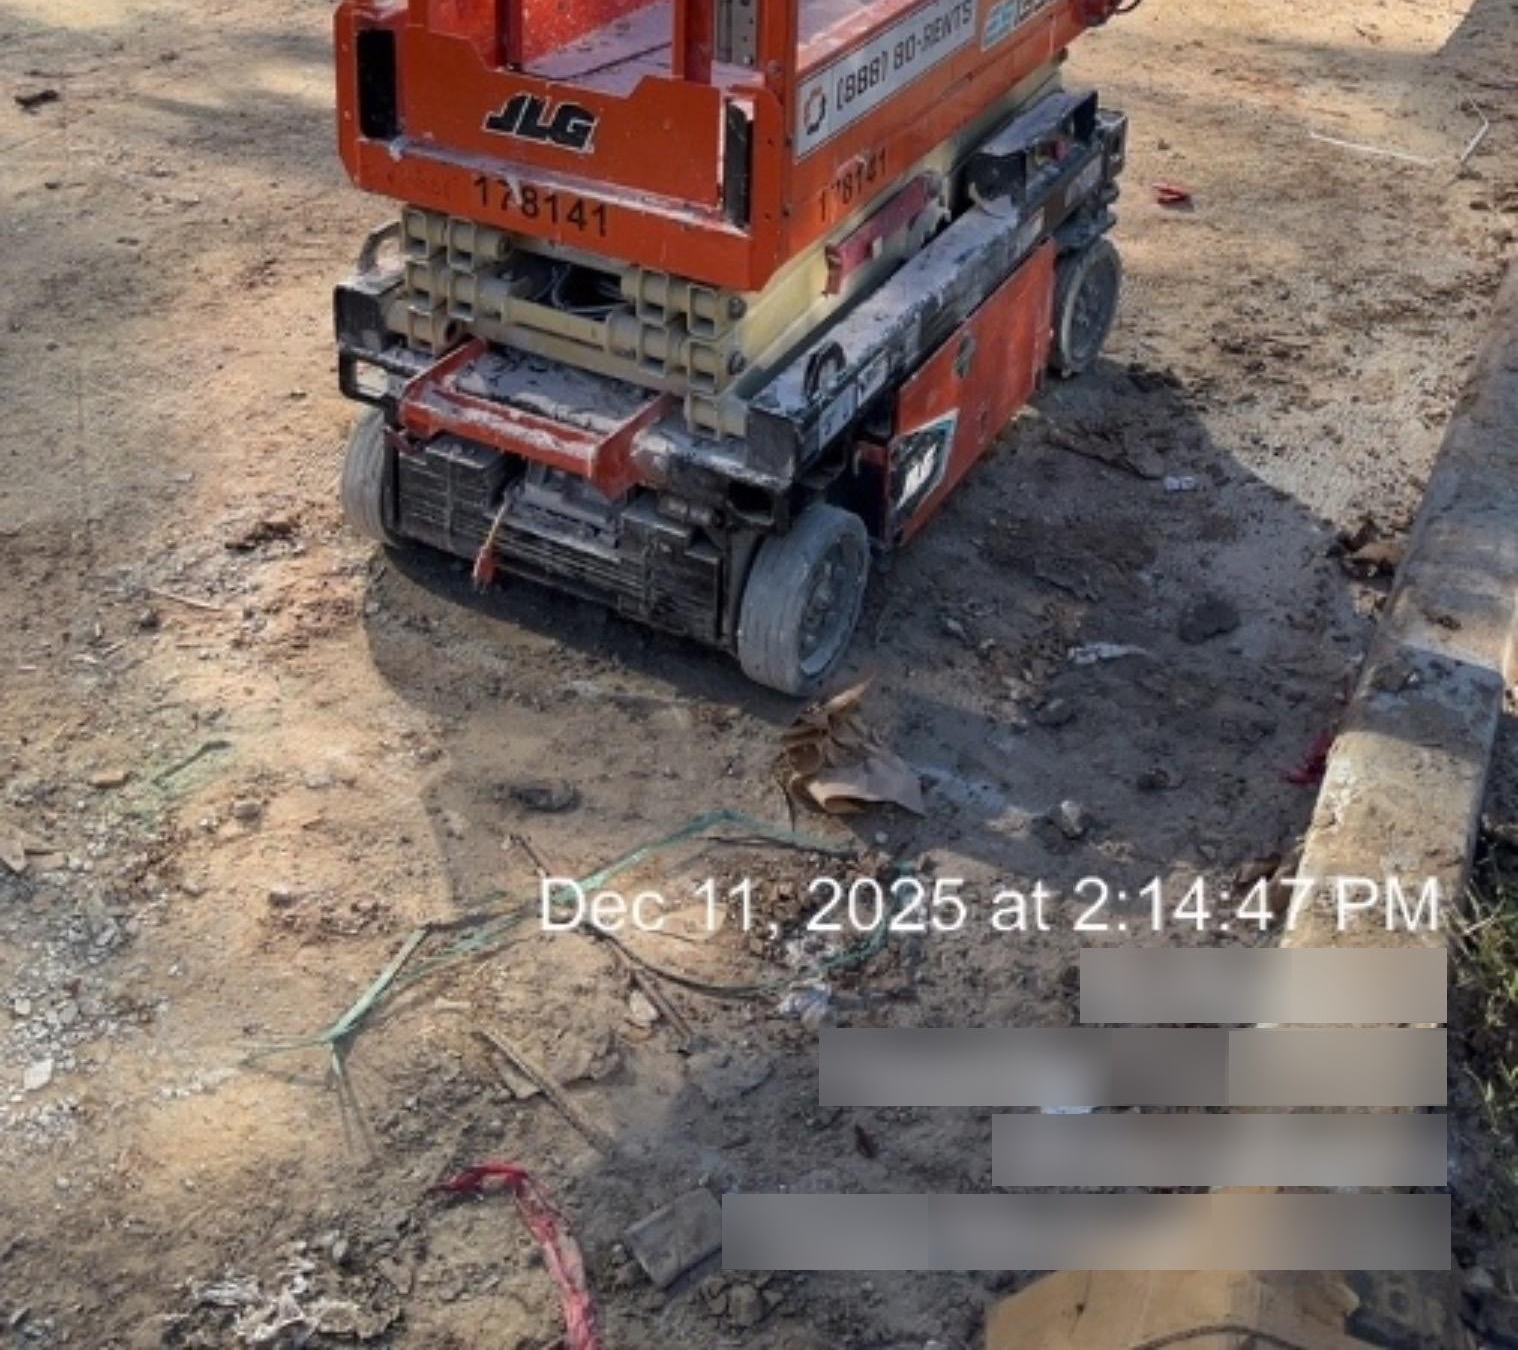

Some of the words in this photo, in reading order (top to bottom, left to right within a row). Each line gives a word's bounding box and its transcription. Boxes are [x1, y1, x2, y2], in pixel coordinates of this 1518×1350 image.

[836, 50, 888, 111] (888)
[482, 90, 598, 153] JLG
[474, 175, 606, 237] 178141
